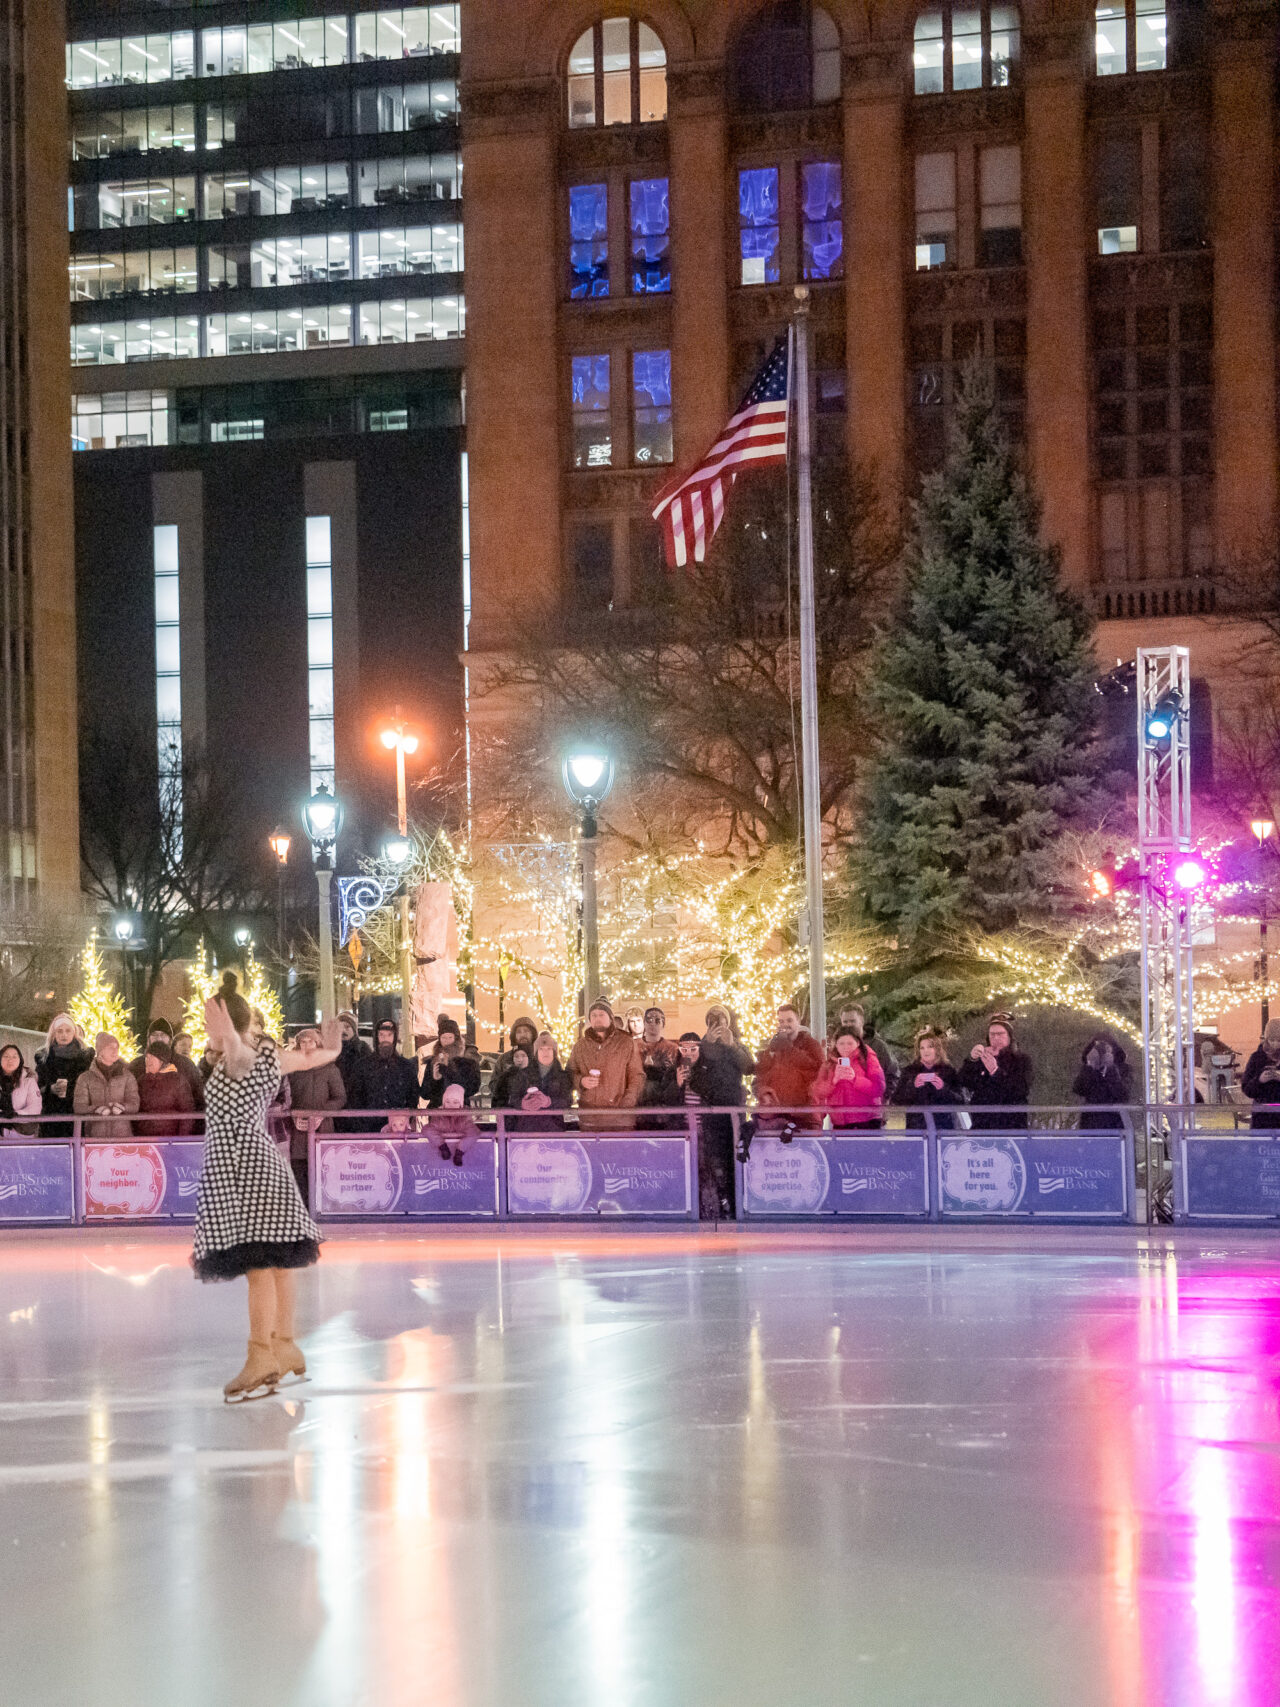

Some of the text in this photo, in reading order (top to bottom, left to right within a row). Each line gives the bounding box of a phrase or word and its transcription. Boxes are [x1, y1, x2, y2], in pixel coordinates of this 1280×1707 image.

[348, 1161, 366, 1170] Your
[536, 1163, 552, 1172] Our
[763, 1158, 801, 1168] Over 100
[982, 1158, 993, 1168] all
[110, 1168, 128, 1176] Your
[340, 1172, 376, 1181] business
[765, 1170, 799, 1180] years of
[969, 1169, 990, 1179] here
[99, 1178, 140, 1189] neighbor.
[341, 1183, 375, 1193] partner.
[440, 1178, 472, 1190] BANK
[630, 1177, 662, 1190] BANK
[868, 1177, 902, 1190] BANK
[964, 1181, 998, 1192] for you.
[1065, 1177, 1099, 1190] BANK
[18, 1183, 48, 1196] BANK
